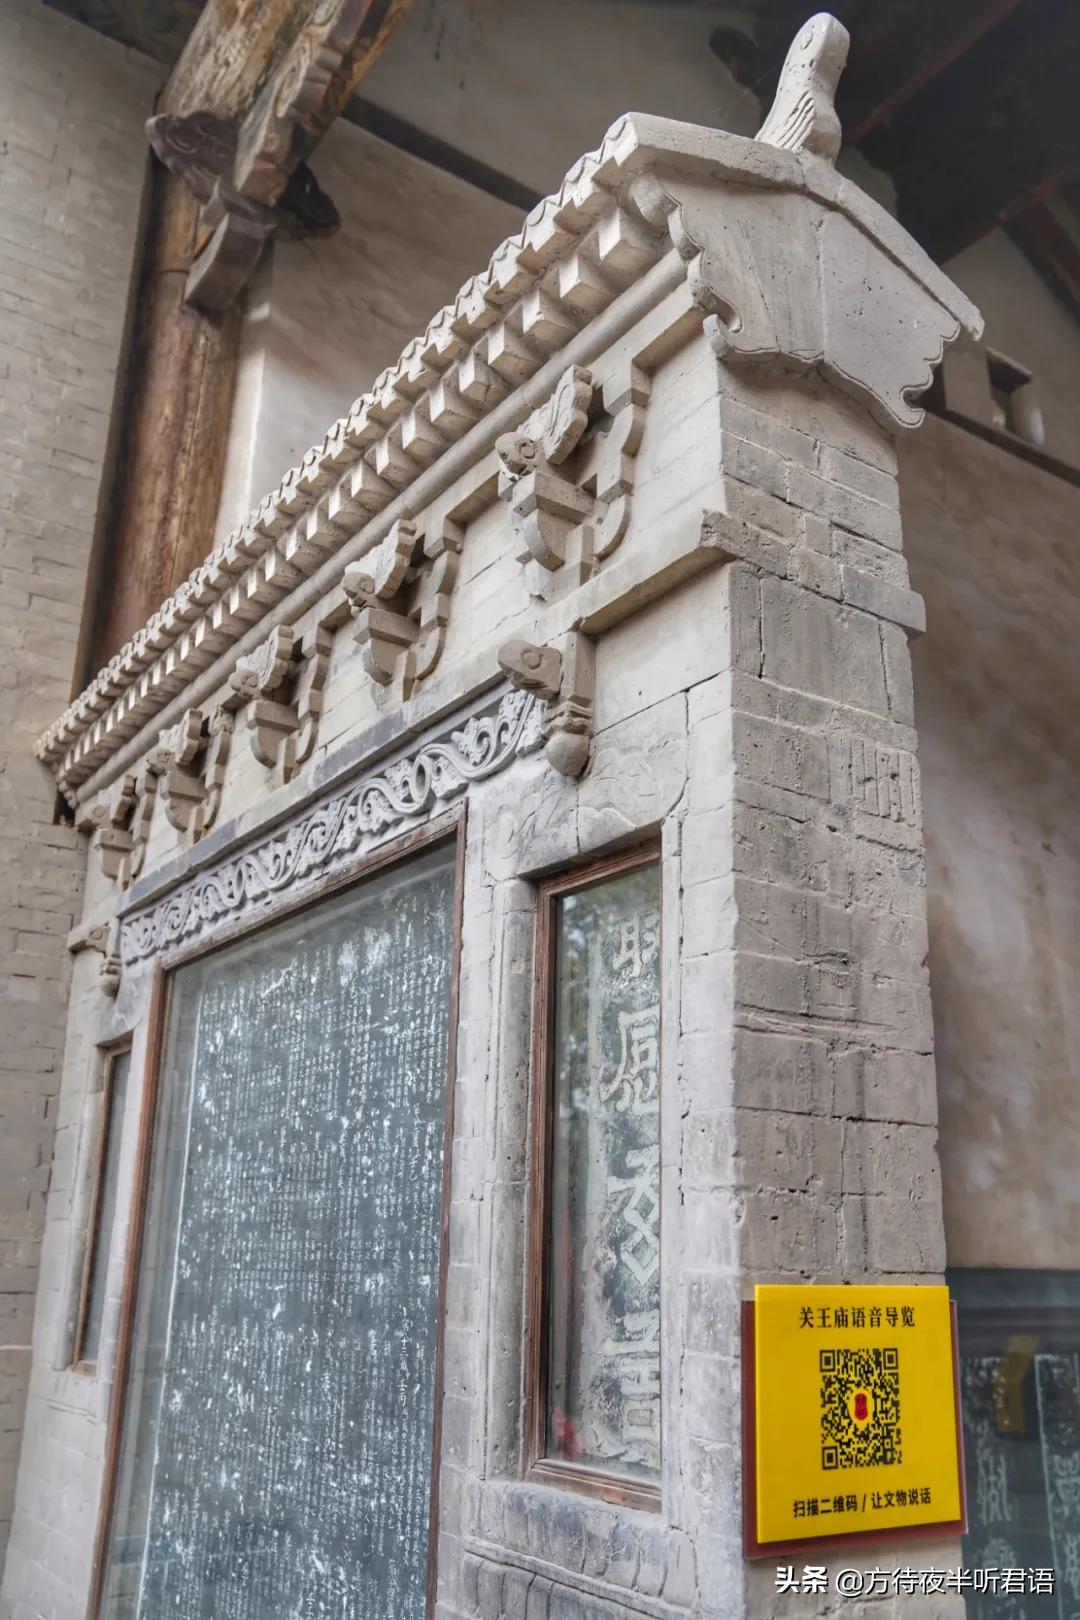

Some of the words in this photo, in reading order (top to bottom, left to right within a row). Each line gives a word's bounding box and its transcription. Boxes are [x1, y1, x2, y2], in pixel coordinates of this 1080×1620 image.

[799, 1306, 916, 1329] 关王庙语音导览
